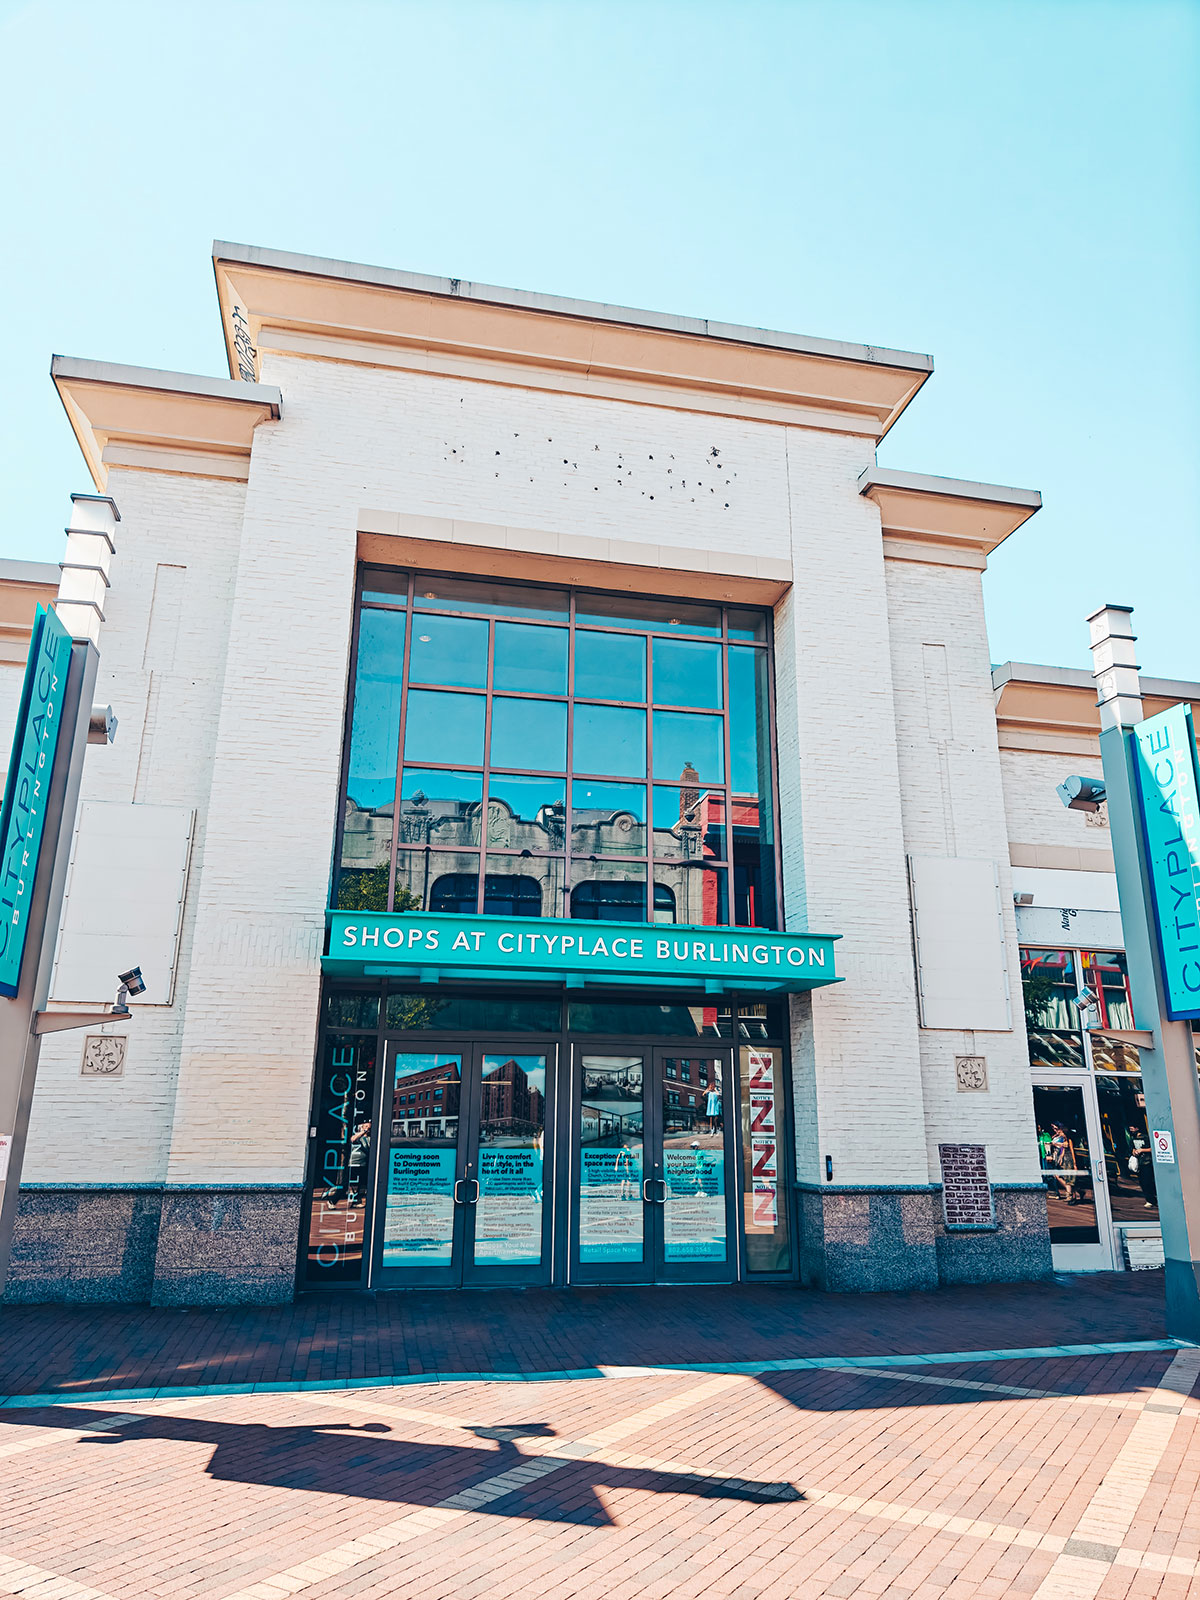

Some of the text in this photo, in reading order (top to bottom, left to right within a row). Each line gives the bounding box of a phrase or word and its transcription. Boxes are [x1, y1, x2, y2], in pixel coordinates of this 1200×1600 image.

[12, 675, 58, 925] BURLINGTON
[1150, 726, 1200, 992] CITYPLACE
[342, 926, 825, 966] SHOPS AT CITYPLACE BURLINGTON
[317, 1048, 354, 1267] CITYPLACE
[345, 1071, 367, 1242] BURLINGTON
[393, 1168, 430, 1176] Burlington
[394, 1153, 421, 1161] Coming
[667, 1168, 712, 1176] neighborhood
